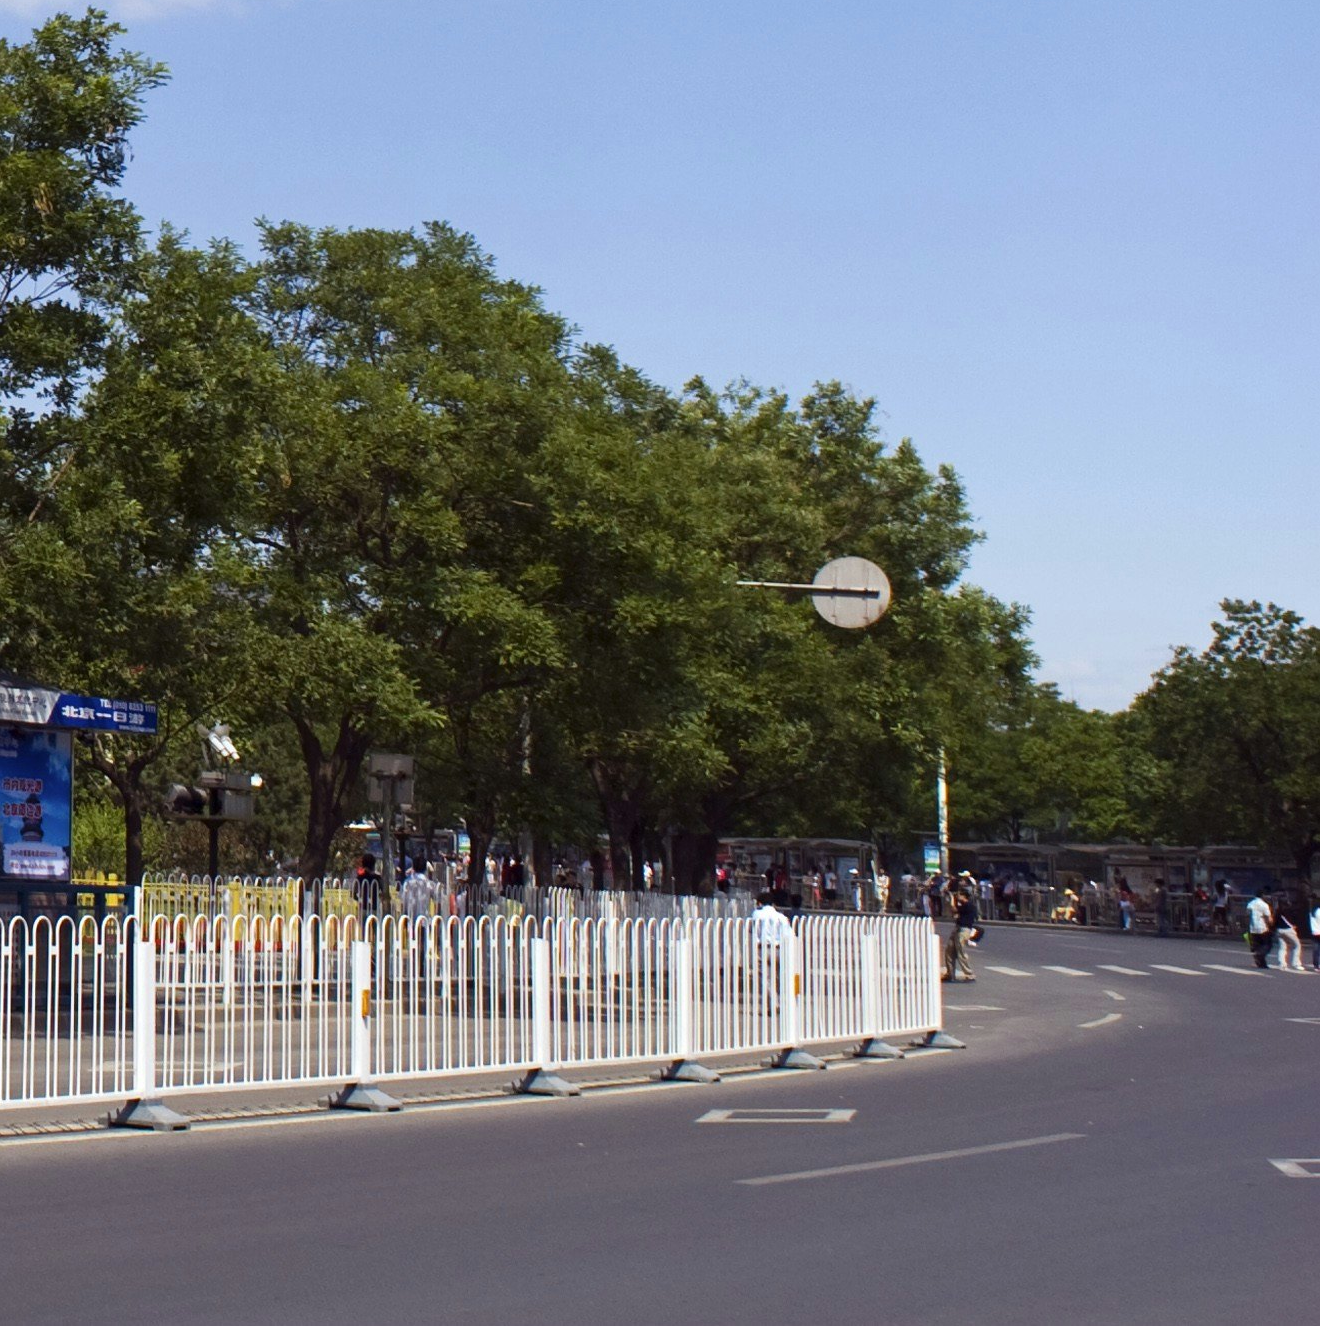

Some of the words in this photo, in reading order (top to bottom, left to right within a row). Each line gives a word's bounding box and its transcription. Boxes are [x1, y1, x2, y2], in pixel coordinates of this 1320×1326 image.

[62, 705, 145, 725] 北京一日游
